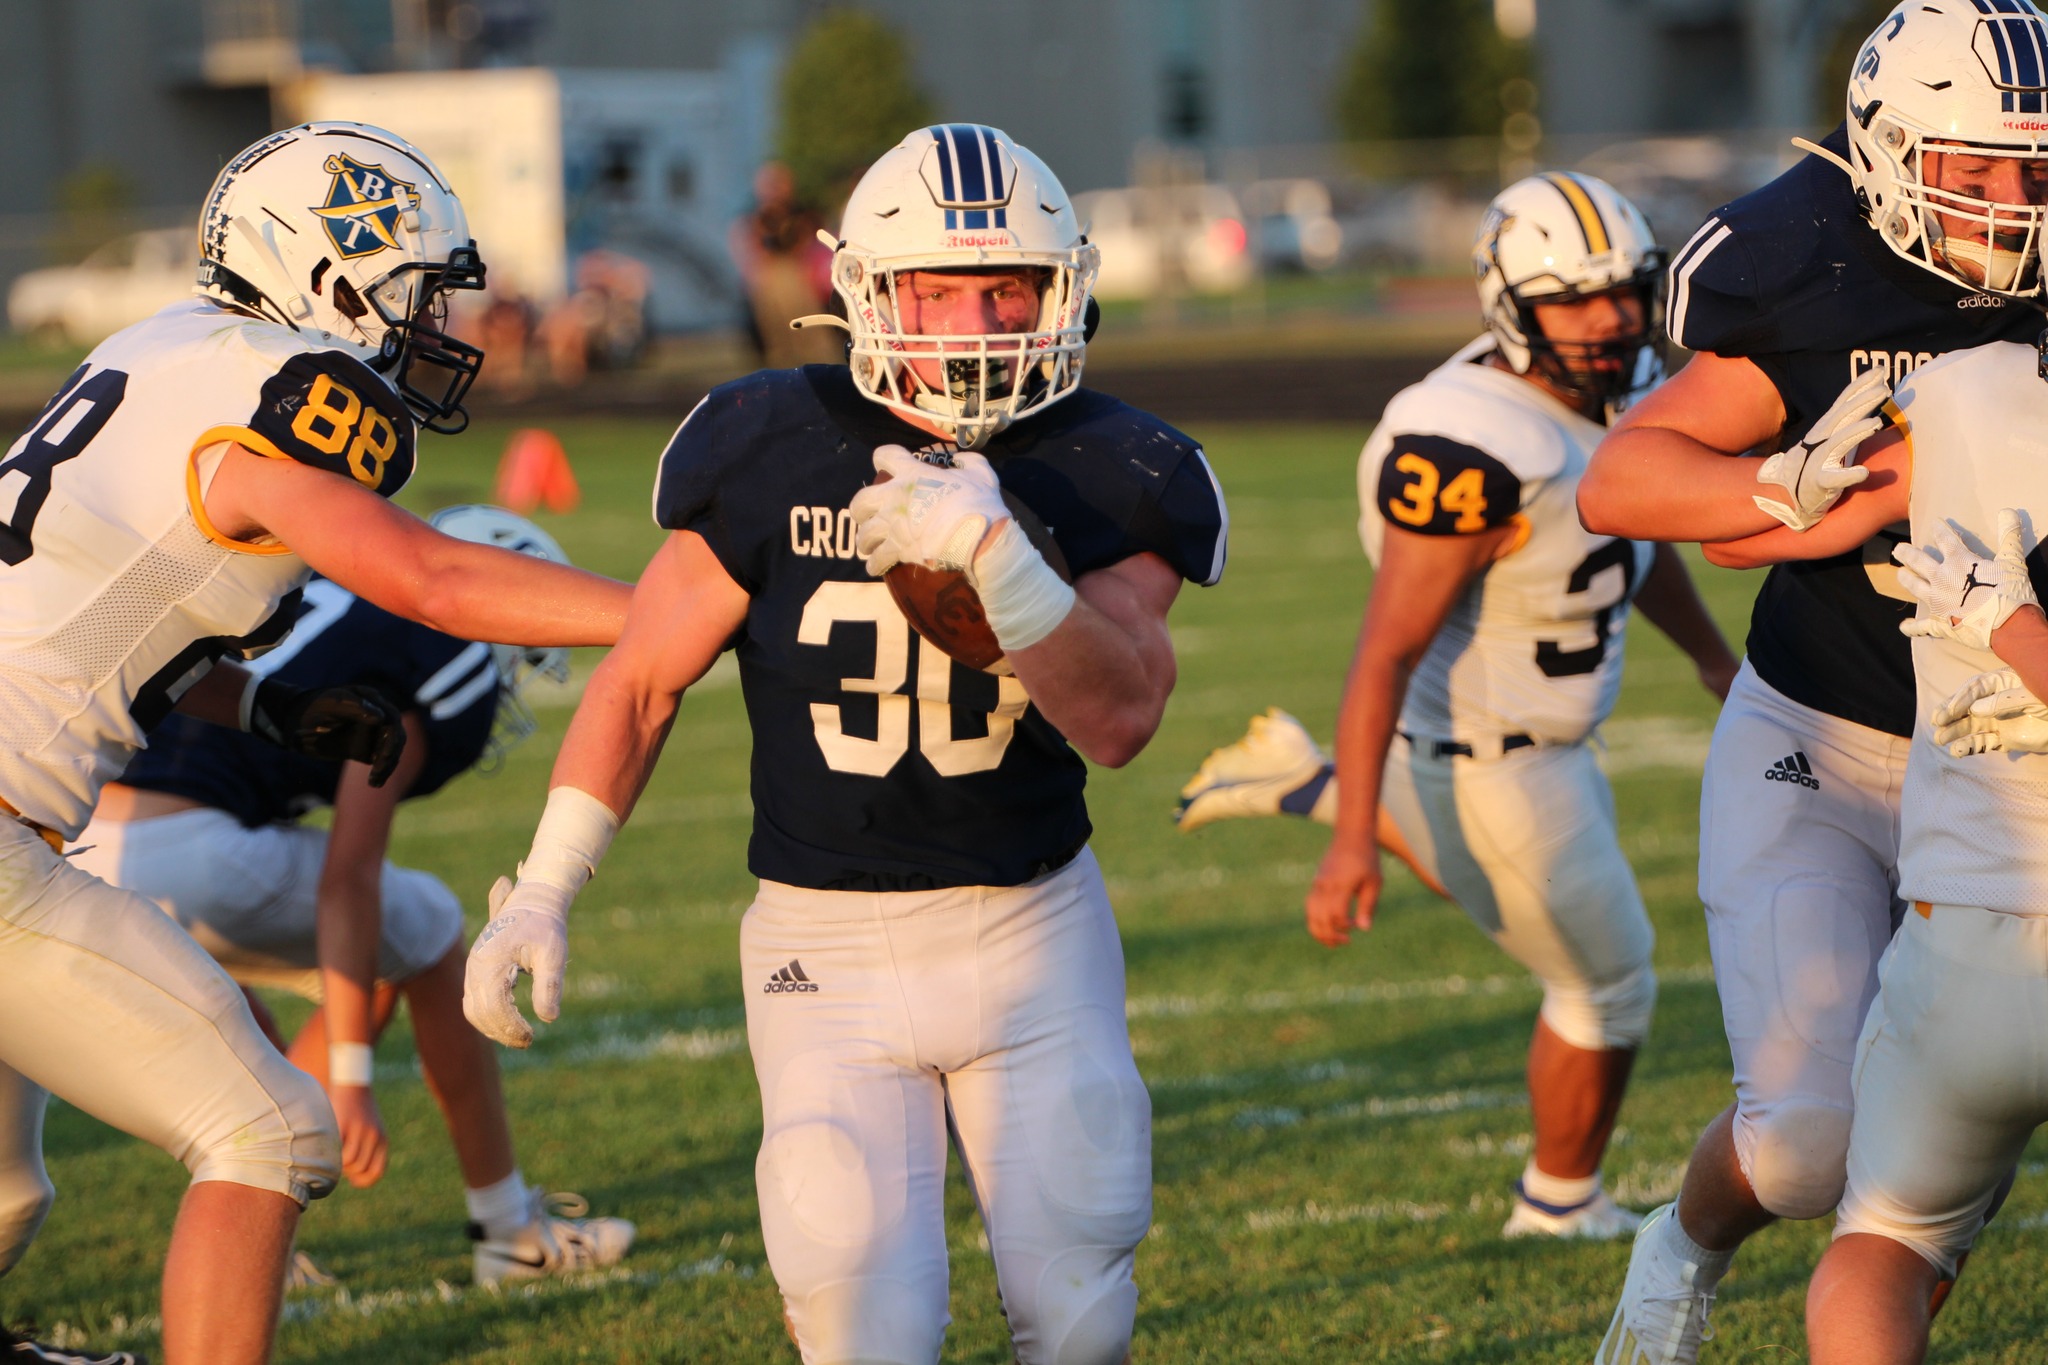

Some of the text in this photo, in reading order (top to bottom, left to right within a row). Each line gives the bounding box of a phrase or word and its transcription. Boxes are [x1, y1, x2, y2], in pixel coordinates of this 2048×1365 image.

[356, 170, 386, 202] B
[341, 215, 373, 250] T
[290, 372, 398, 491] 88
[1388, 452, 1488, 533] 34
[790, 505, 870, 561] CRO
[797, 580, 1031, 778] 30
[1764, 766, 1820, 791] adidas
[763, 979, 820, 994] adidas
